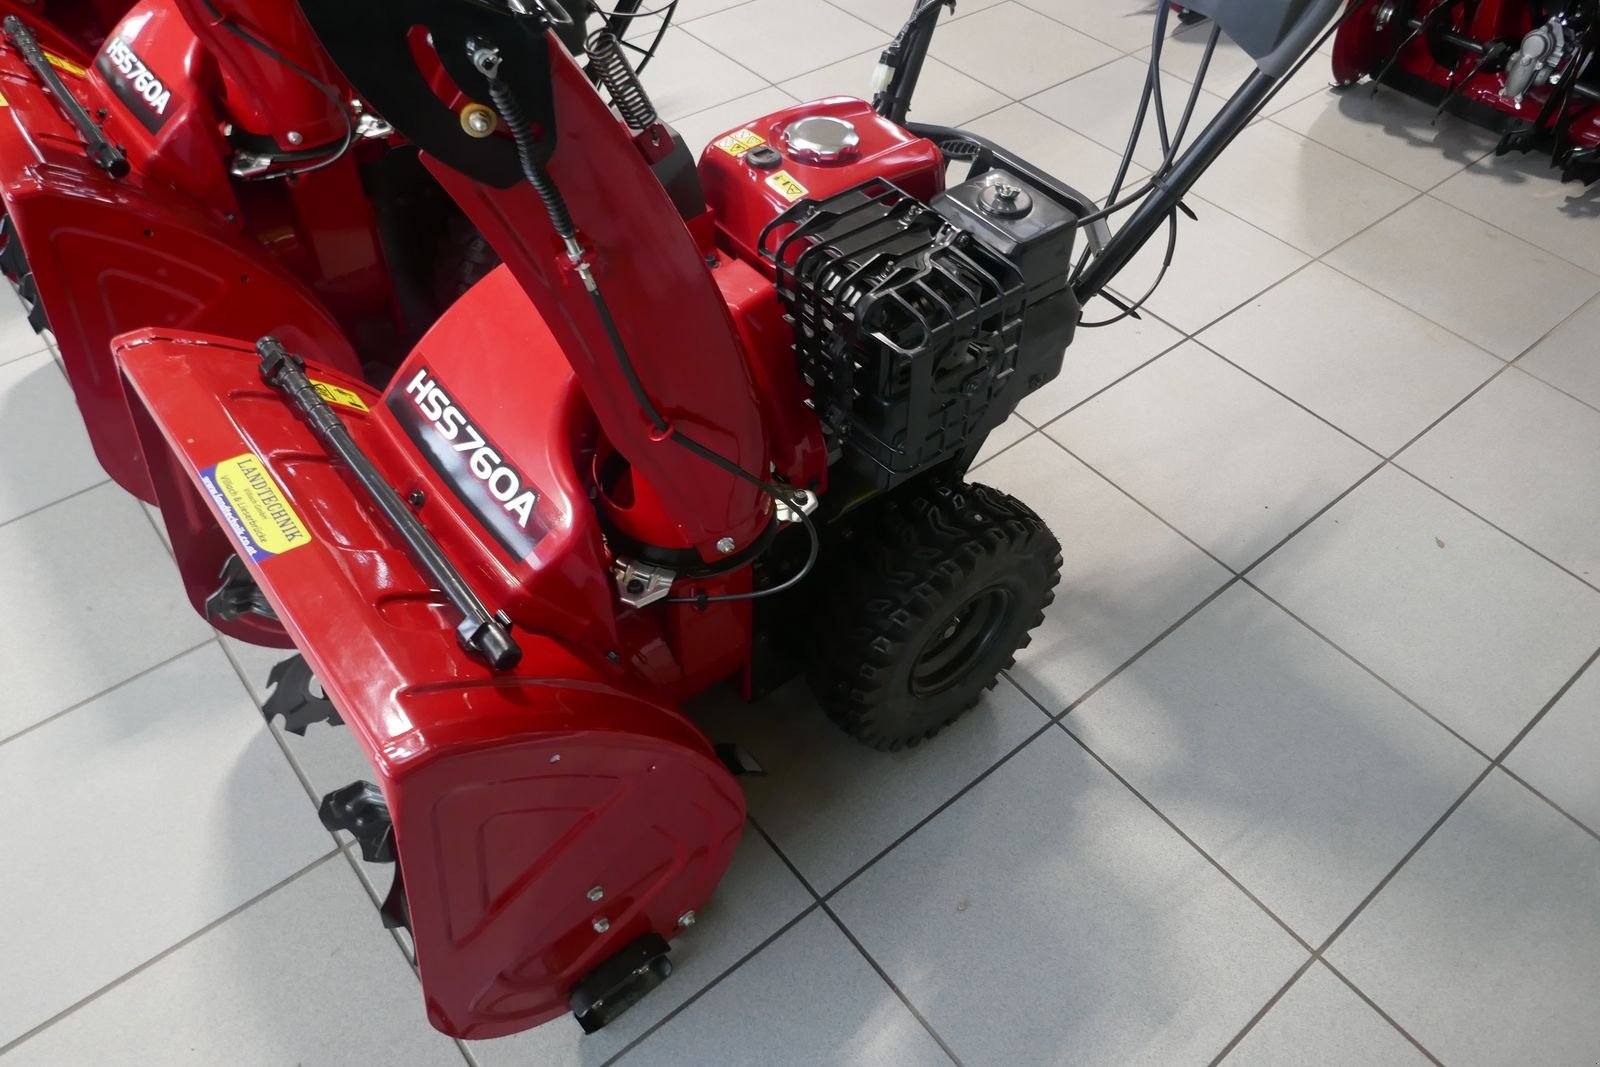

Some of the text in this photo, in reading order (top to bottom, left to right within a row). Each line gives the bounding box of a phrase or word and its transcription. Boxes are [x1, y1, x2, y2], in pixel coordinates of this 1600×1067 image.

[106, 37, 171, 115] HSS760A
[406, 369, 536, 528] HSS760A
[202, 476, 257, 556] www.landtechnik.co.at
[220, 475, 238, 494] Villach
[237, 501, 268, 543] Lieserbrücke
[237, 459, 303, 542] LANDTECHNIK
